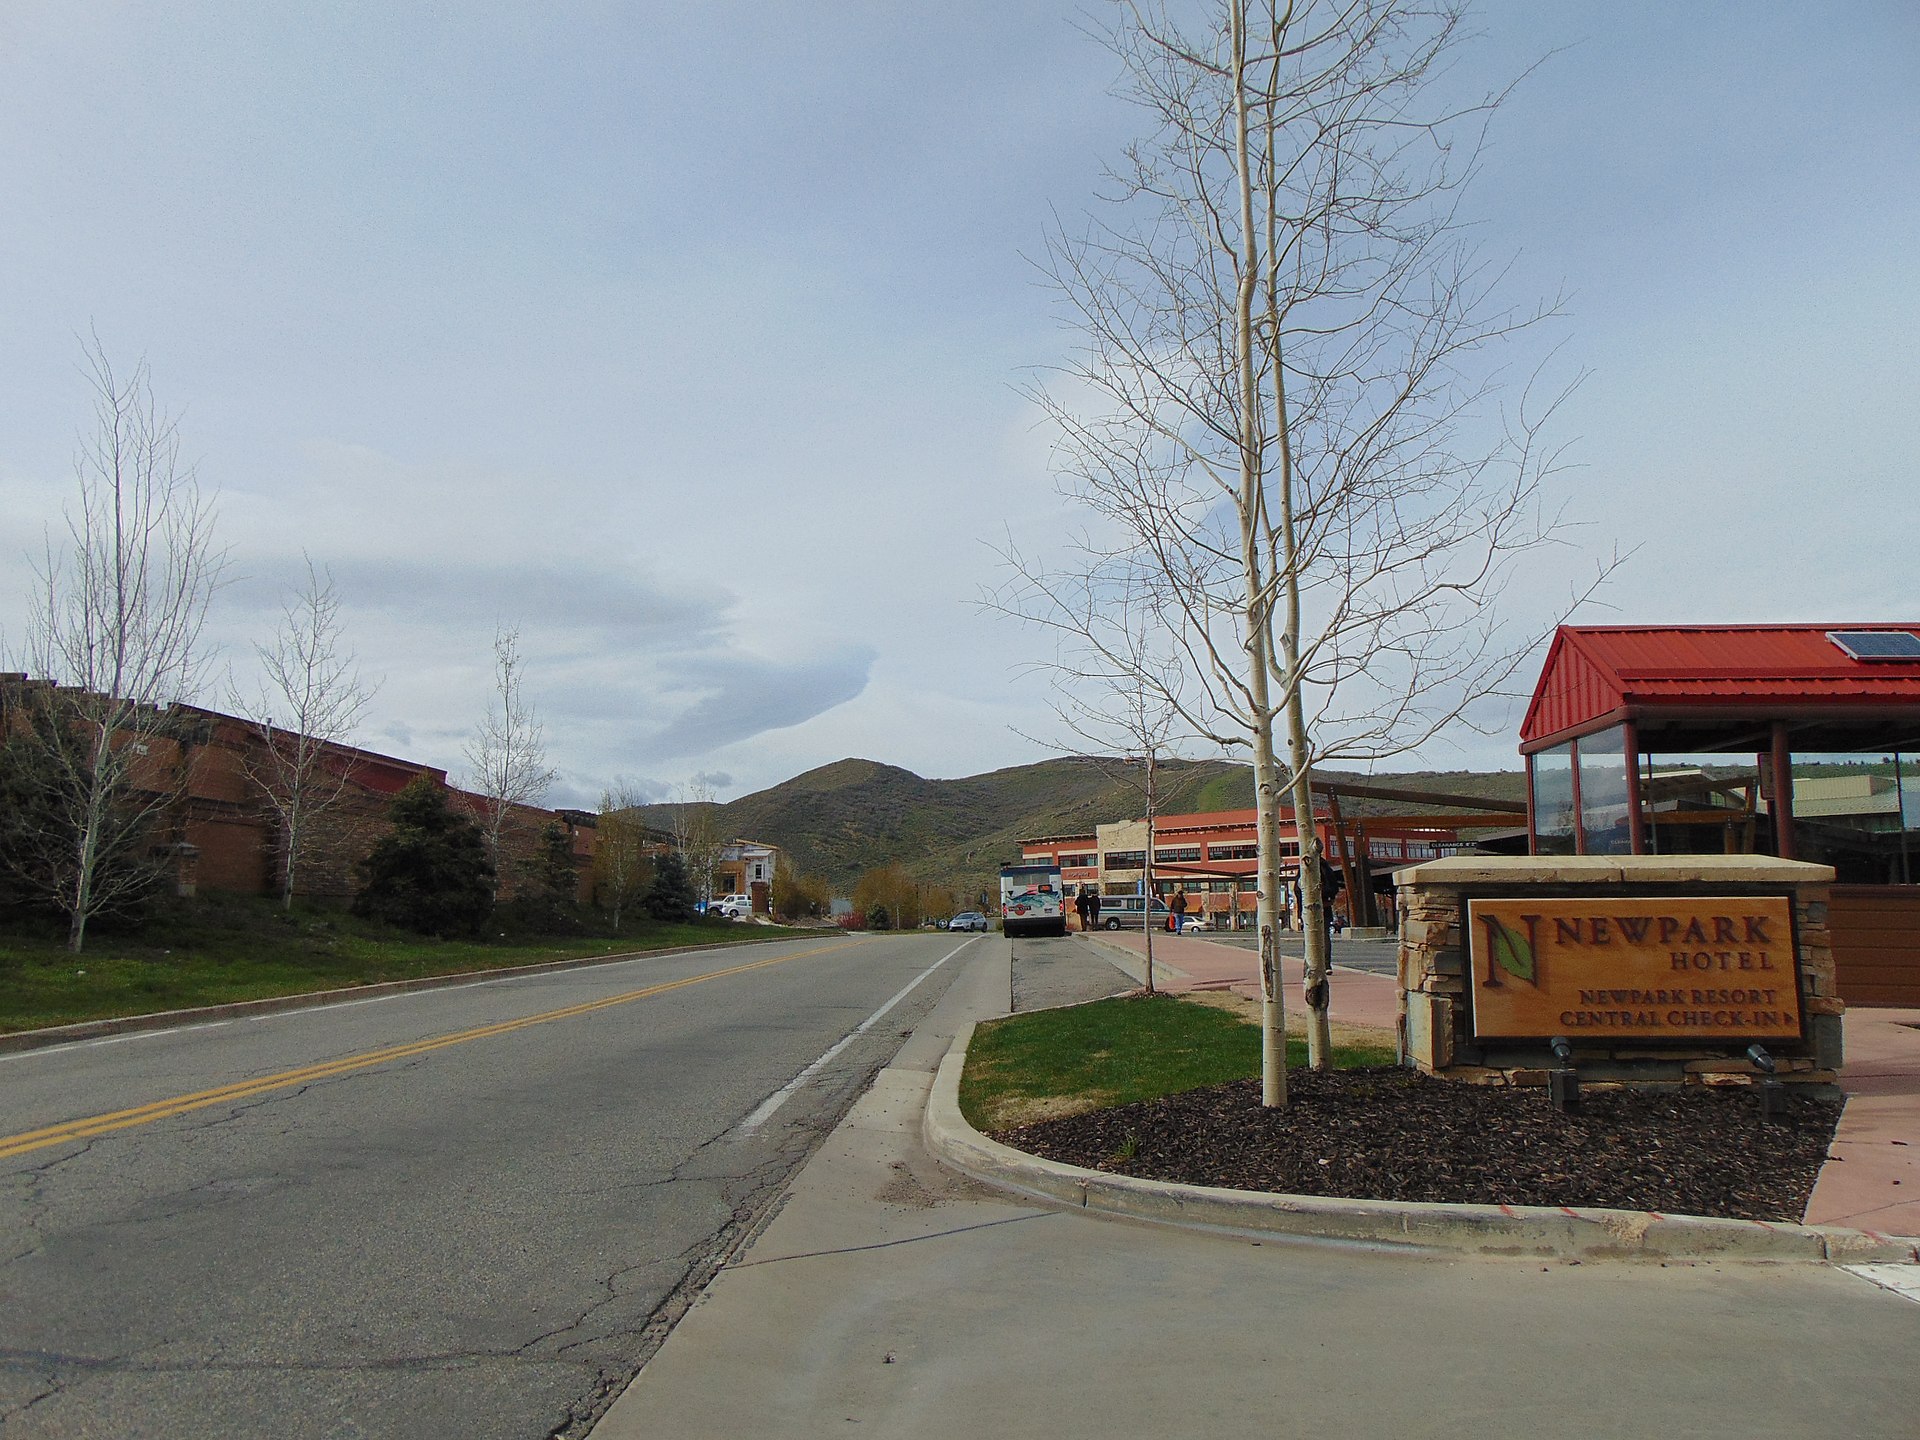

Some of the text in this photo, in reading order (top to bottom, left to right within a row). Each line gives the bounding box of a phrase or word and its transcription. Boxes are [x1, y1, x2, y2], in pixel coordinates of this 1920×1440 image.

[1553, 916, 1772, 945] NEWPARK
[1670, 951, 1774, 970] HOTEL
[1578, 989, 1776, 1005] NEWPARK RESORT
[1559, 1010, 1777, 1027] CENTRAL CHECK-IN
